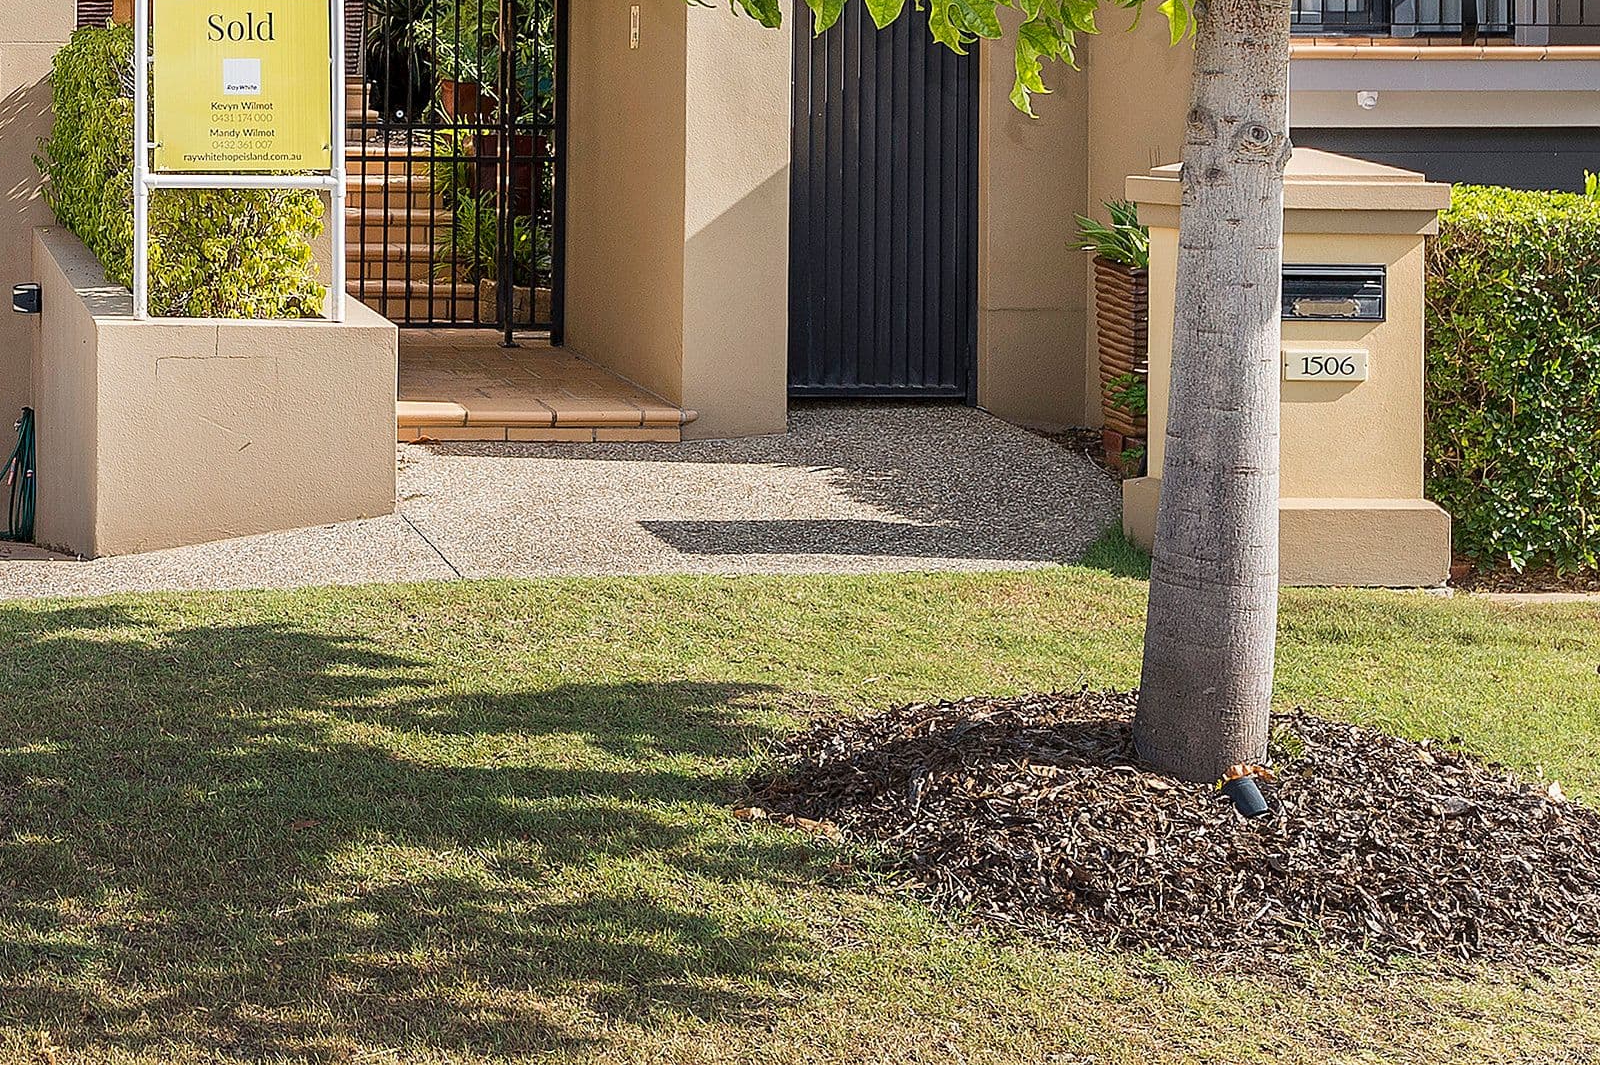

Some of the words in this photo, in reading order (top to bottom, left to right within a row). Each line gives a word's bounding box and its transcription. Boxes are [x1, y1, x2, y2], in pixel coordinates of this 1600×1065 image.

[207, 12, 275, 41] Sold
[210, 102, 239, 112] Kevyn
[241, 102, 274, 111] Wilmot
[210, 129, 241, 139] Mandy
[242, 129, 275, 137] Wilmot
[183, 152, 302, 162] raywhitehopeisland.com.au
[1301, 356, 1355, 376] 1506
